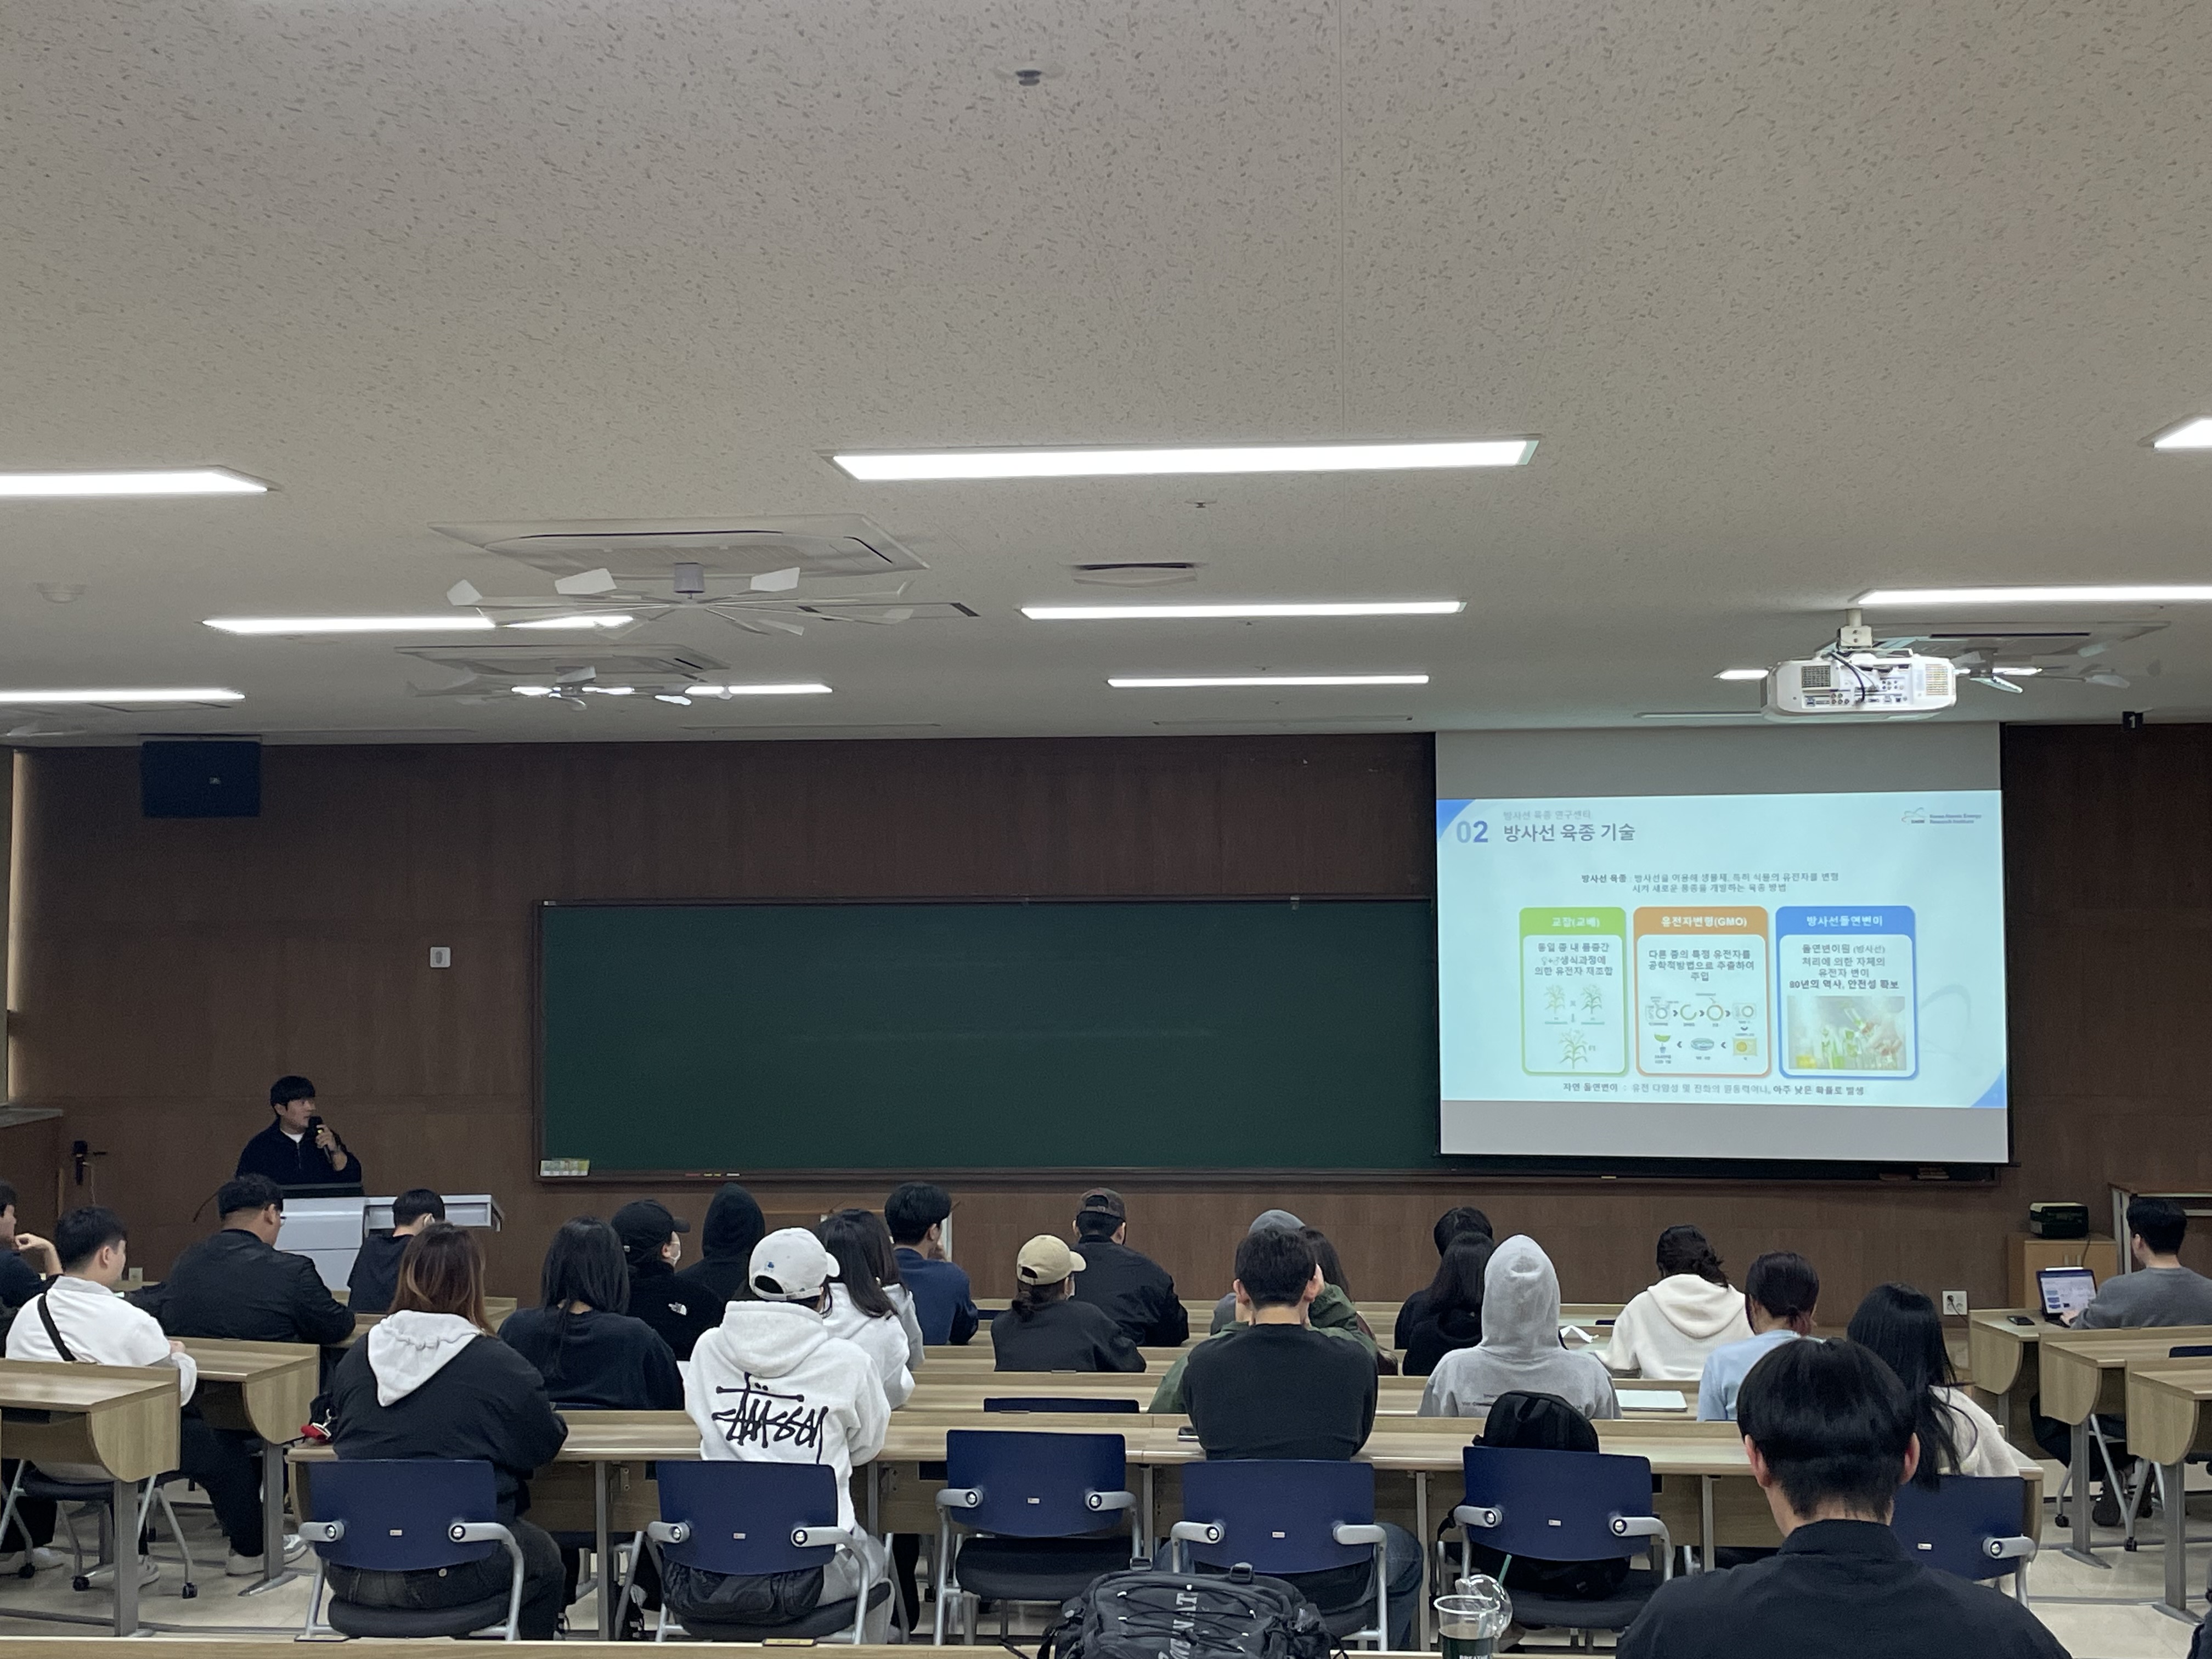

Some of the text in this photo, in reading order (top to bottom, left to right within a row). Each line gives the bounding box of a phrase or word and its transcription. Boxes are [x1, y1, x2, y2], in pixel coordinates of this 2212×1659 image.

[1503, 810, 1591, 821] 방사선 육종 연구센터
[1456, 820, 1488, 843] 02
[1504, 823, 1636, 843] 방사선 육종 기술
[1581, 874, 1607, 883] 방사선
[1610, 874, 1627, 883] 육종
[1652, 884, 1678, 893] 새로운
[1768, 883, 1786, 893] 방법
[1661, 916, 1747, 928] 유전자변형(GMO)
[1807, 916, 1883, 927] 방사선돌연변이
[1538, 943, 1555, 953] 동일
[1558, 943, 1567, 953] 종
[1570, 943, 1579, 952] 내
[1802, 944, 1886, 954] 돌연변이원 (방사선)
[1649, 949, 1751, 960] 다른 종의 특정 유전자를
[1717, 961, 1754, 970] 추출하여
[1802, 957, 1831, 967] 처리에
[1833, 957, 1853, 967] 의한
[1534, 966, 1613, 977] 의한 유전자 재조합
[1690, 972, 1709, 981] 주입
[1818, 968, 1870, 978] 유전자 변이
[1848, 979, 1876, 990] 안전성
[1880, 979, 1900, 990] 확보
[1563, 1082, 1581, 1092] 자연
[1583, 1082, 1618, 1092] 돌연변이
[1632, 1084, 1649, 1093] 유전
[1773, 1085, 1791, 1094] 아주
[1795, 1085, 1812, 1095] 낮은
[1815, 1085, 1843, 1095] 확률로
[1846, 1086, 1864, 1096] 발생
